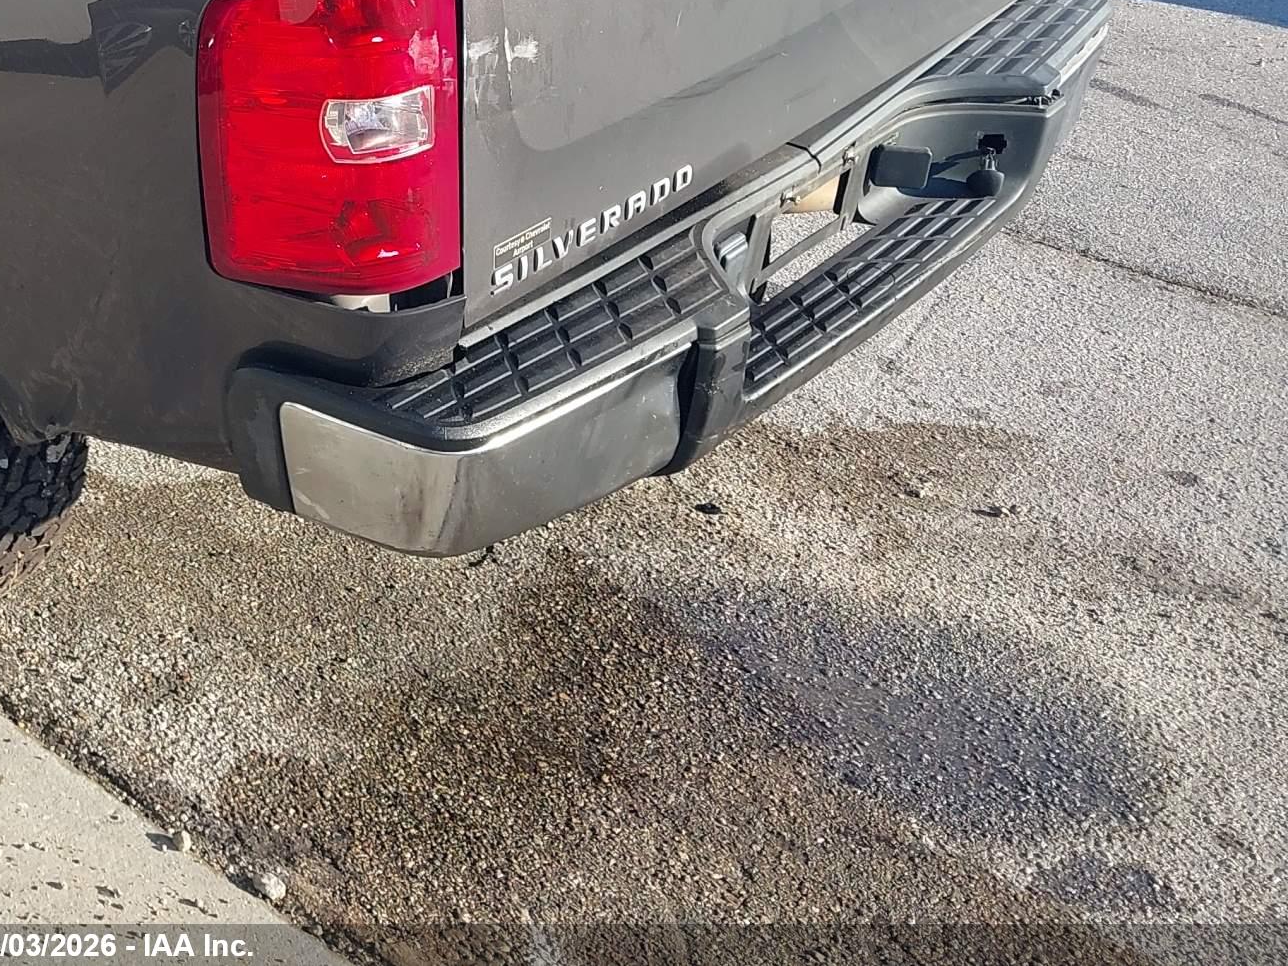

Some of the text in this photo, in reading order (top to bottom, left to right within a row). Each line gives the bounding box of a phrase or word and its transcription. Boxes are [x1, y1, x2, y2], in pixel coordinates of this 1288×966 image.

[492, 164, 693, 296] SILVERADO
[495, 238, 521, 256] Courtesy
[513, 240, 533, 257] Airport
